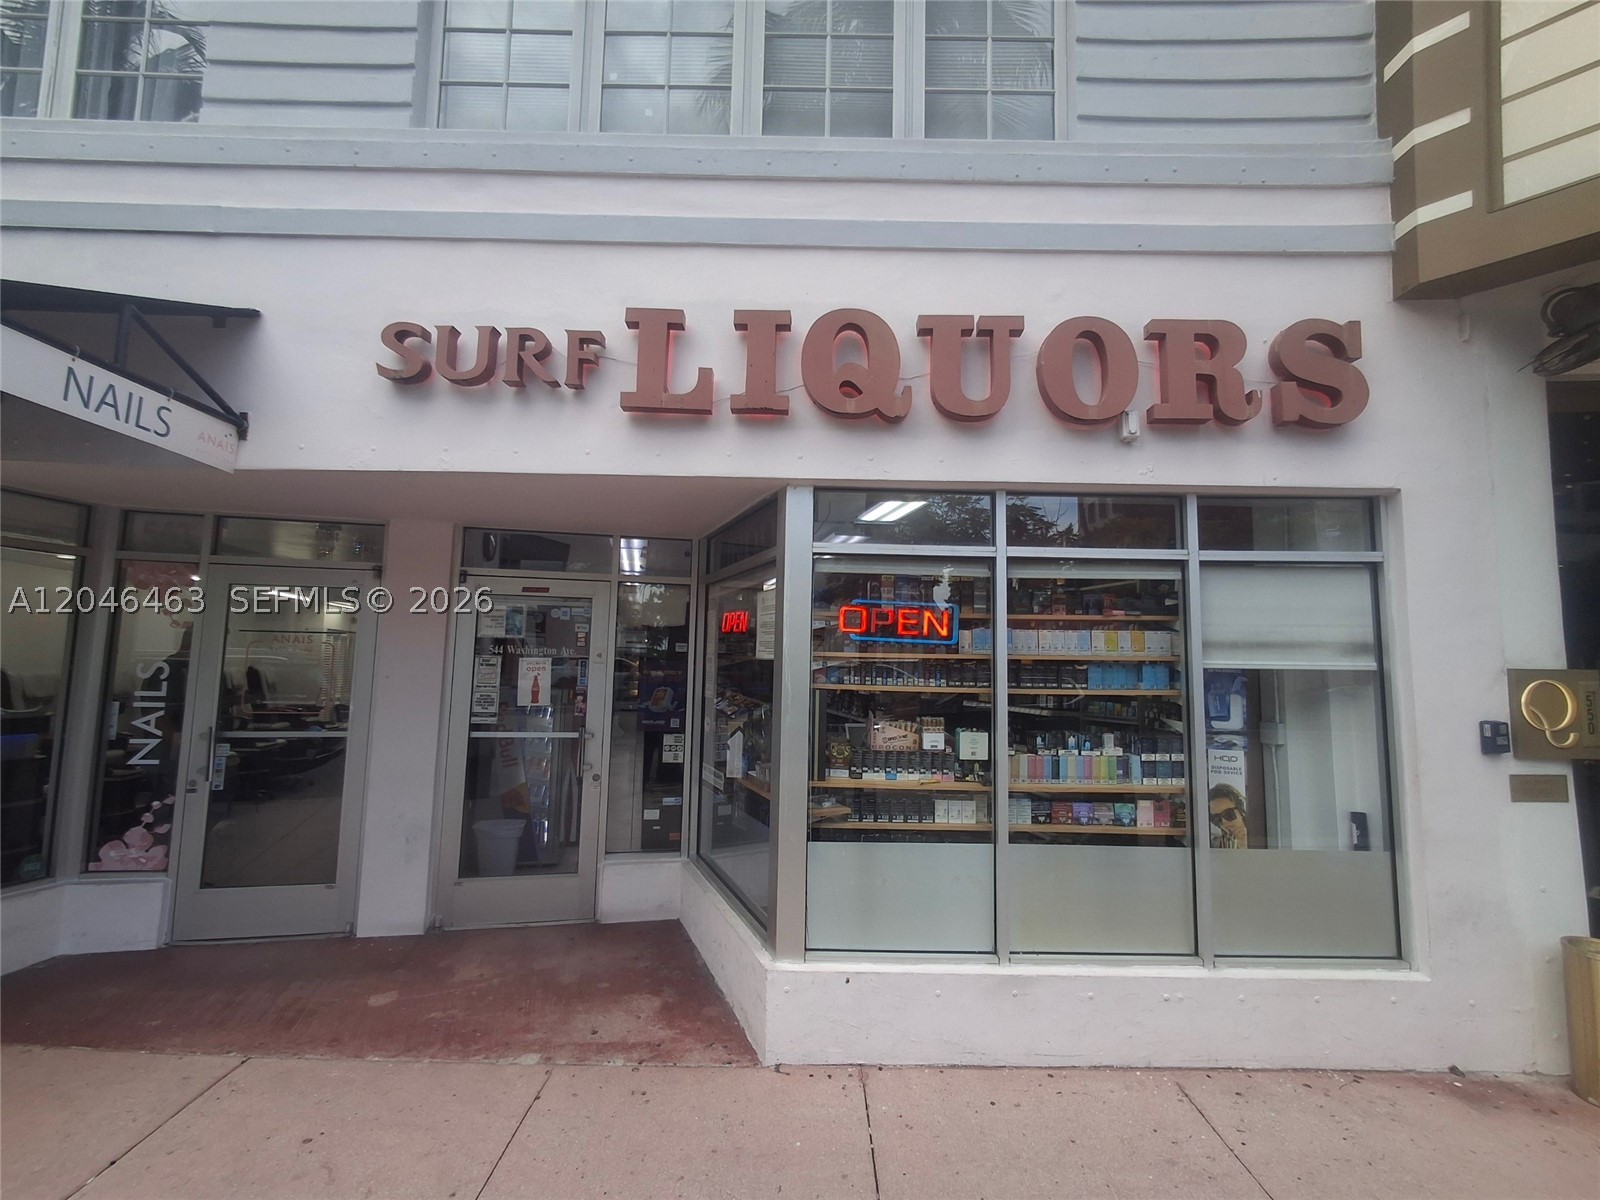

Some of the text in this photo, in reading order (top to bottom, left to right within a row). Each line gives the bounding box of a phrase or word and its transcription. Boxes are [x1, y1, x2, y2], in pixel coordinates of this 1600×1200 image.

[376, 307, 1370, 429] SURF LIQUORS
[62, 365, 172, 438] NAILS
[722, 611, 748, 632] OPEN
[839, 605, 949, 637] OPEN
[507, 644, 557, 657] Washington
[127, 661, 170, 765] NAILS
[1214, 755, 1238, 763] HQD
